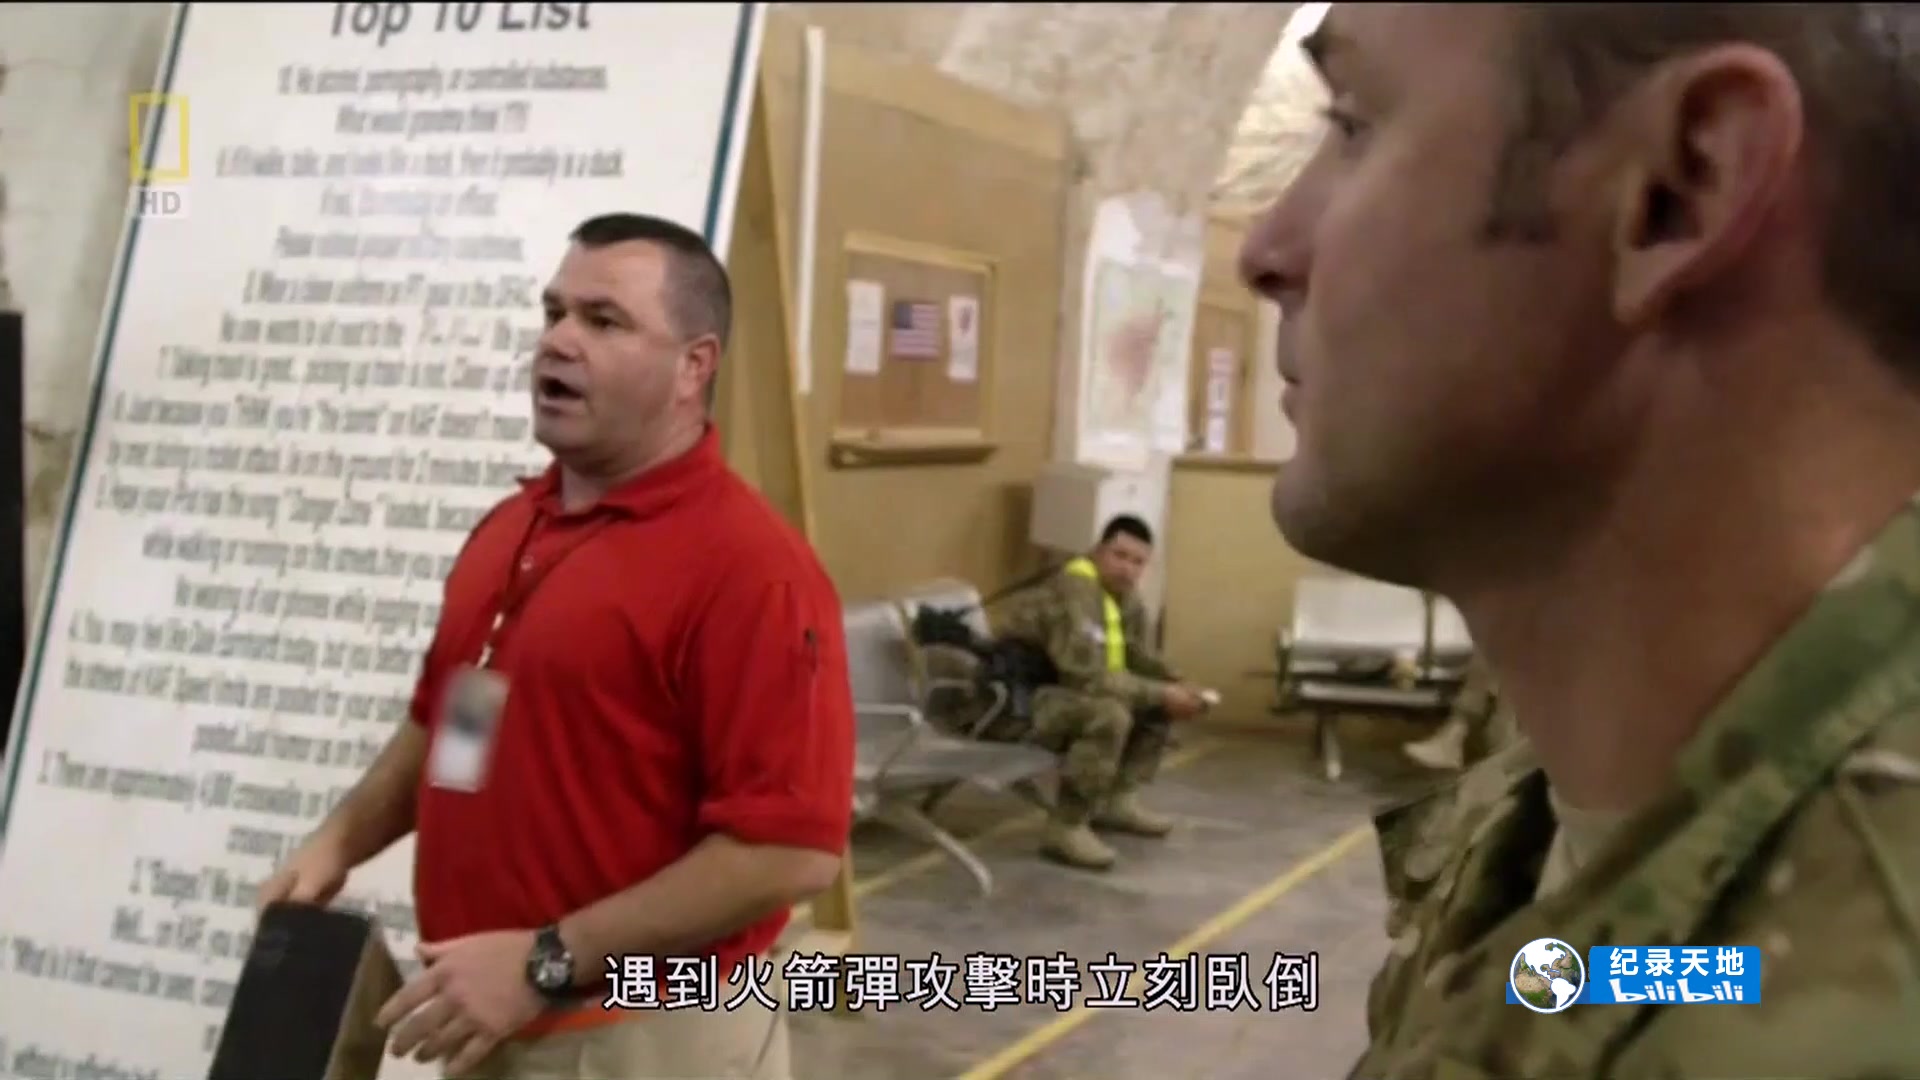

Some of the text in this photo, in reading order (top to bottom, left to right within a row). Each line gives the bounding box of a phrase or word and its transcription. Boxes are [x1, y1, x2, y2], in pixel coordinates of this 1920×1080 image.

[331, 2, 590, 47] Top 10 List
